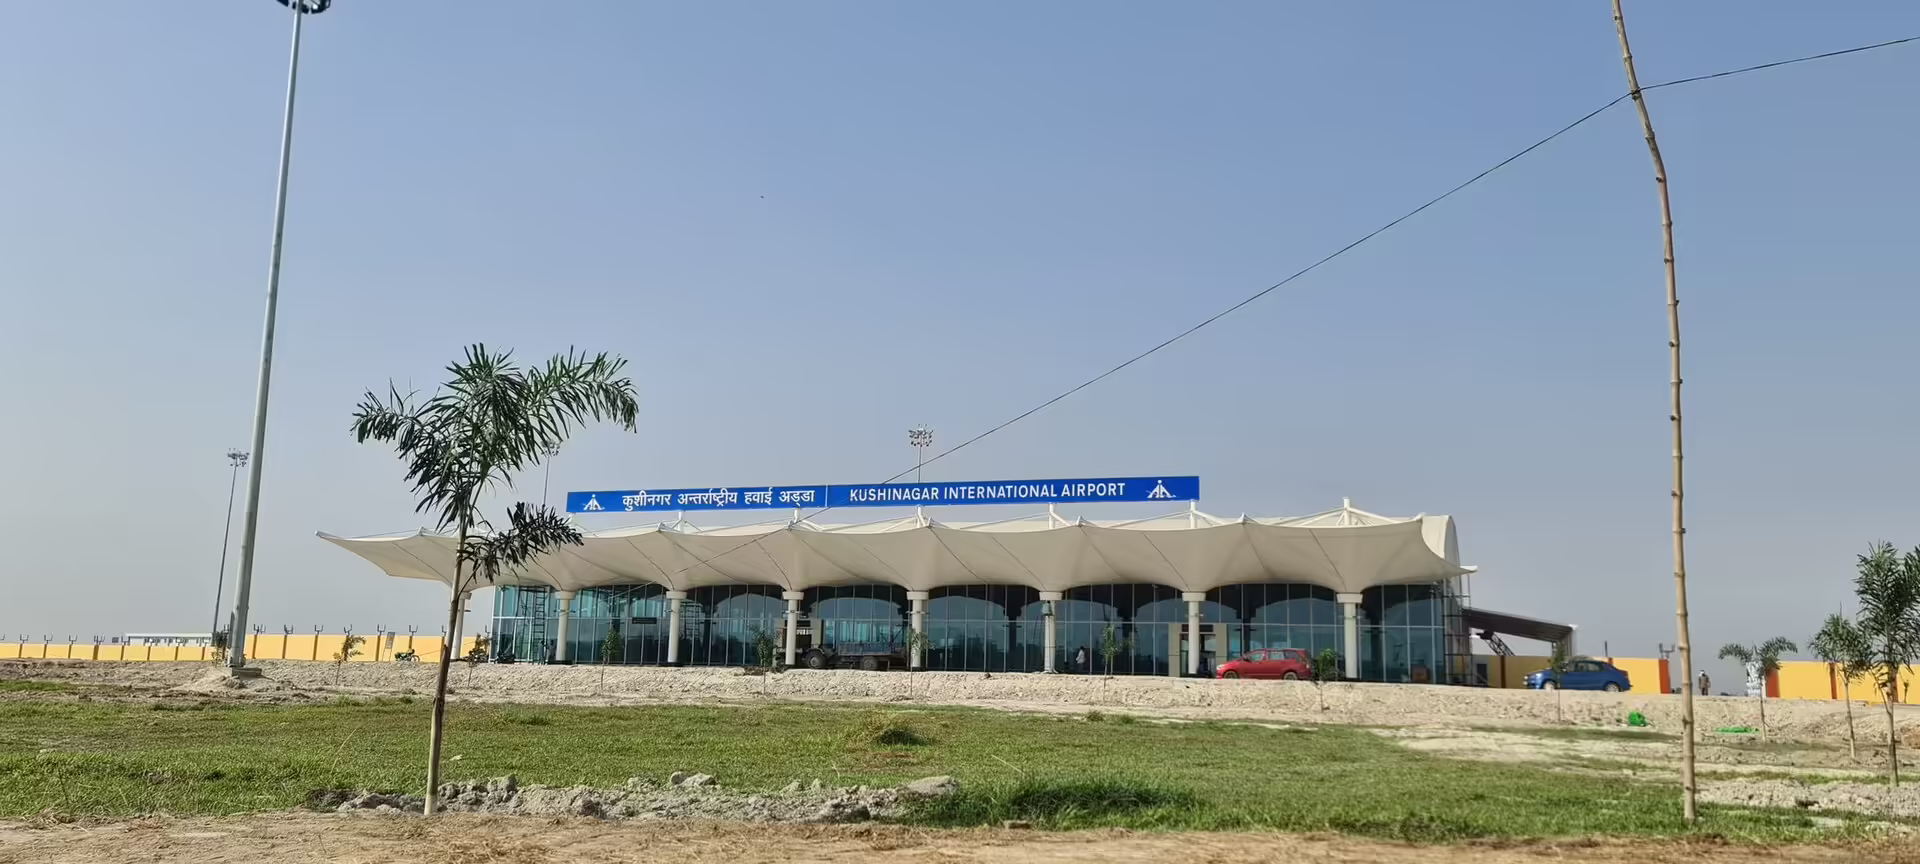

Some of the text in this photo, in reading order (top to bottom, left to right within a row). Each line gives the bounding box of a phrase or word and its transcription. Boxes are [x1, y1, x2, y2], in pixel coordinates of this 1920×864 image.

[622, 487, 815, 511] कुशीनगर अन्तर्राष्ट्रीय हवाई अड्डा
[850, 482, 1125, 502] KUSHINAGAR INTERNATIONAL AIRPORT
